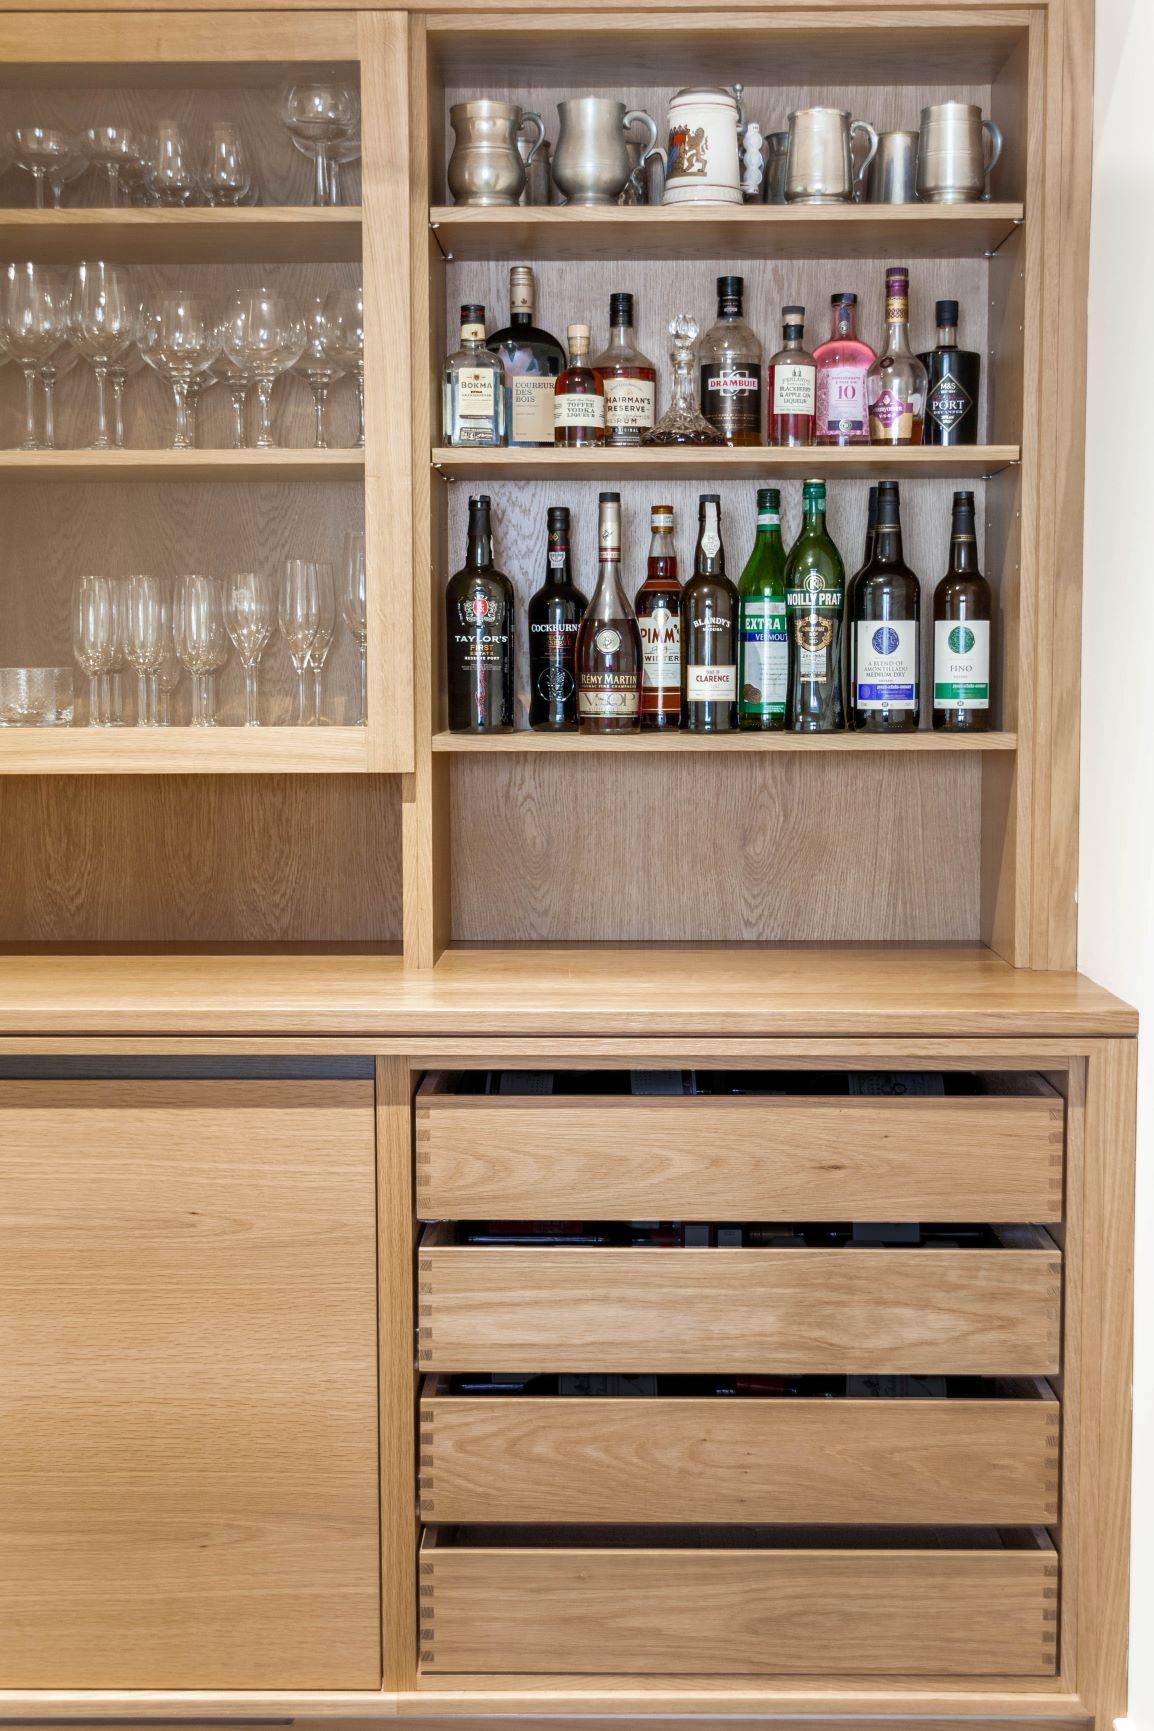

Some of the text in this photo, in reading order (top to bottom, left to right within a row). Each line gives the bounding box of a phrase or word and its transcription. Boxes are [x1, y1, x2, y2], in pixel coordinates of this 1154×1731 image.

[710, 380, 757, 388] DRAMBUIE
[606, 397, 651, 405] HAIRMAN'S
[932, 400, 965, 410] PORT
[608, 405, 646, 413] RESERVE
[787, 593, 840, 606] NOILLY PRAT
[693, 616, 731, 628] BLANDY'S
[745, 618, 781, 630] EXTRA
[455, 635, 508, 643] TAYLOR'S
[755, 633, 787, 641] VERMOUT
[582, 674, 637, 684] RÉMY MARTIN
